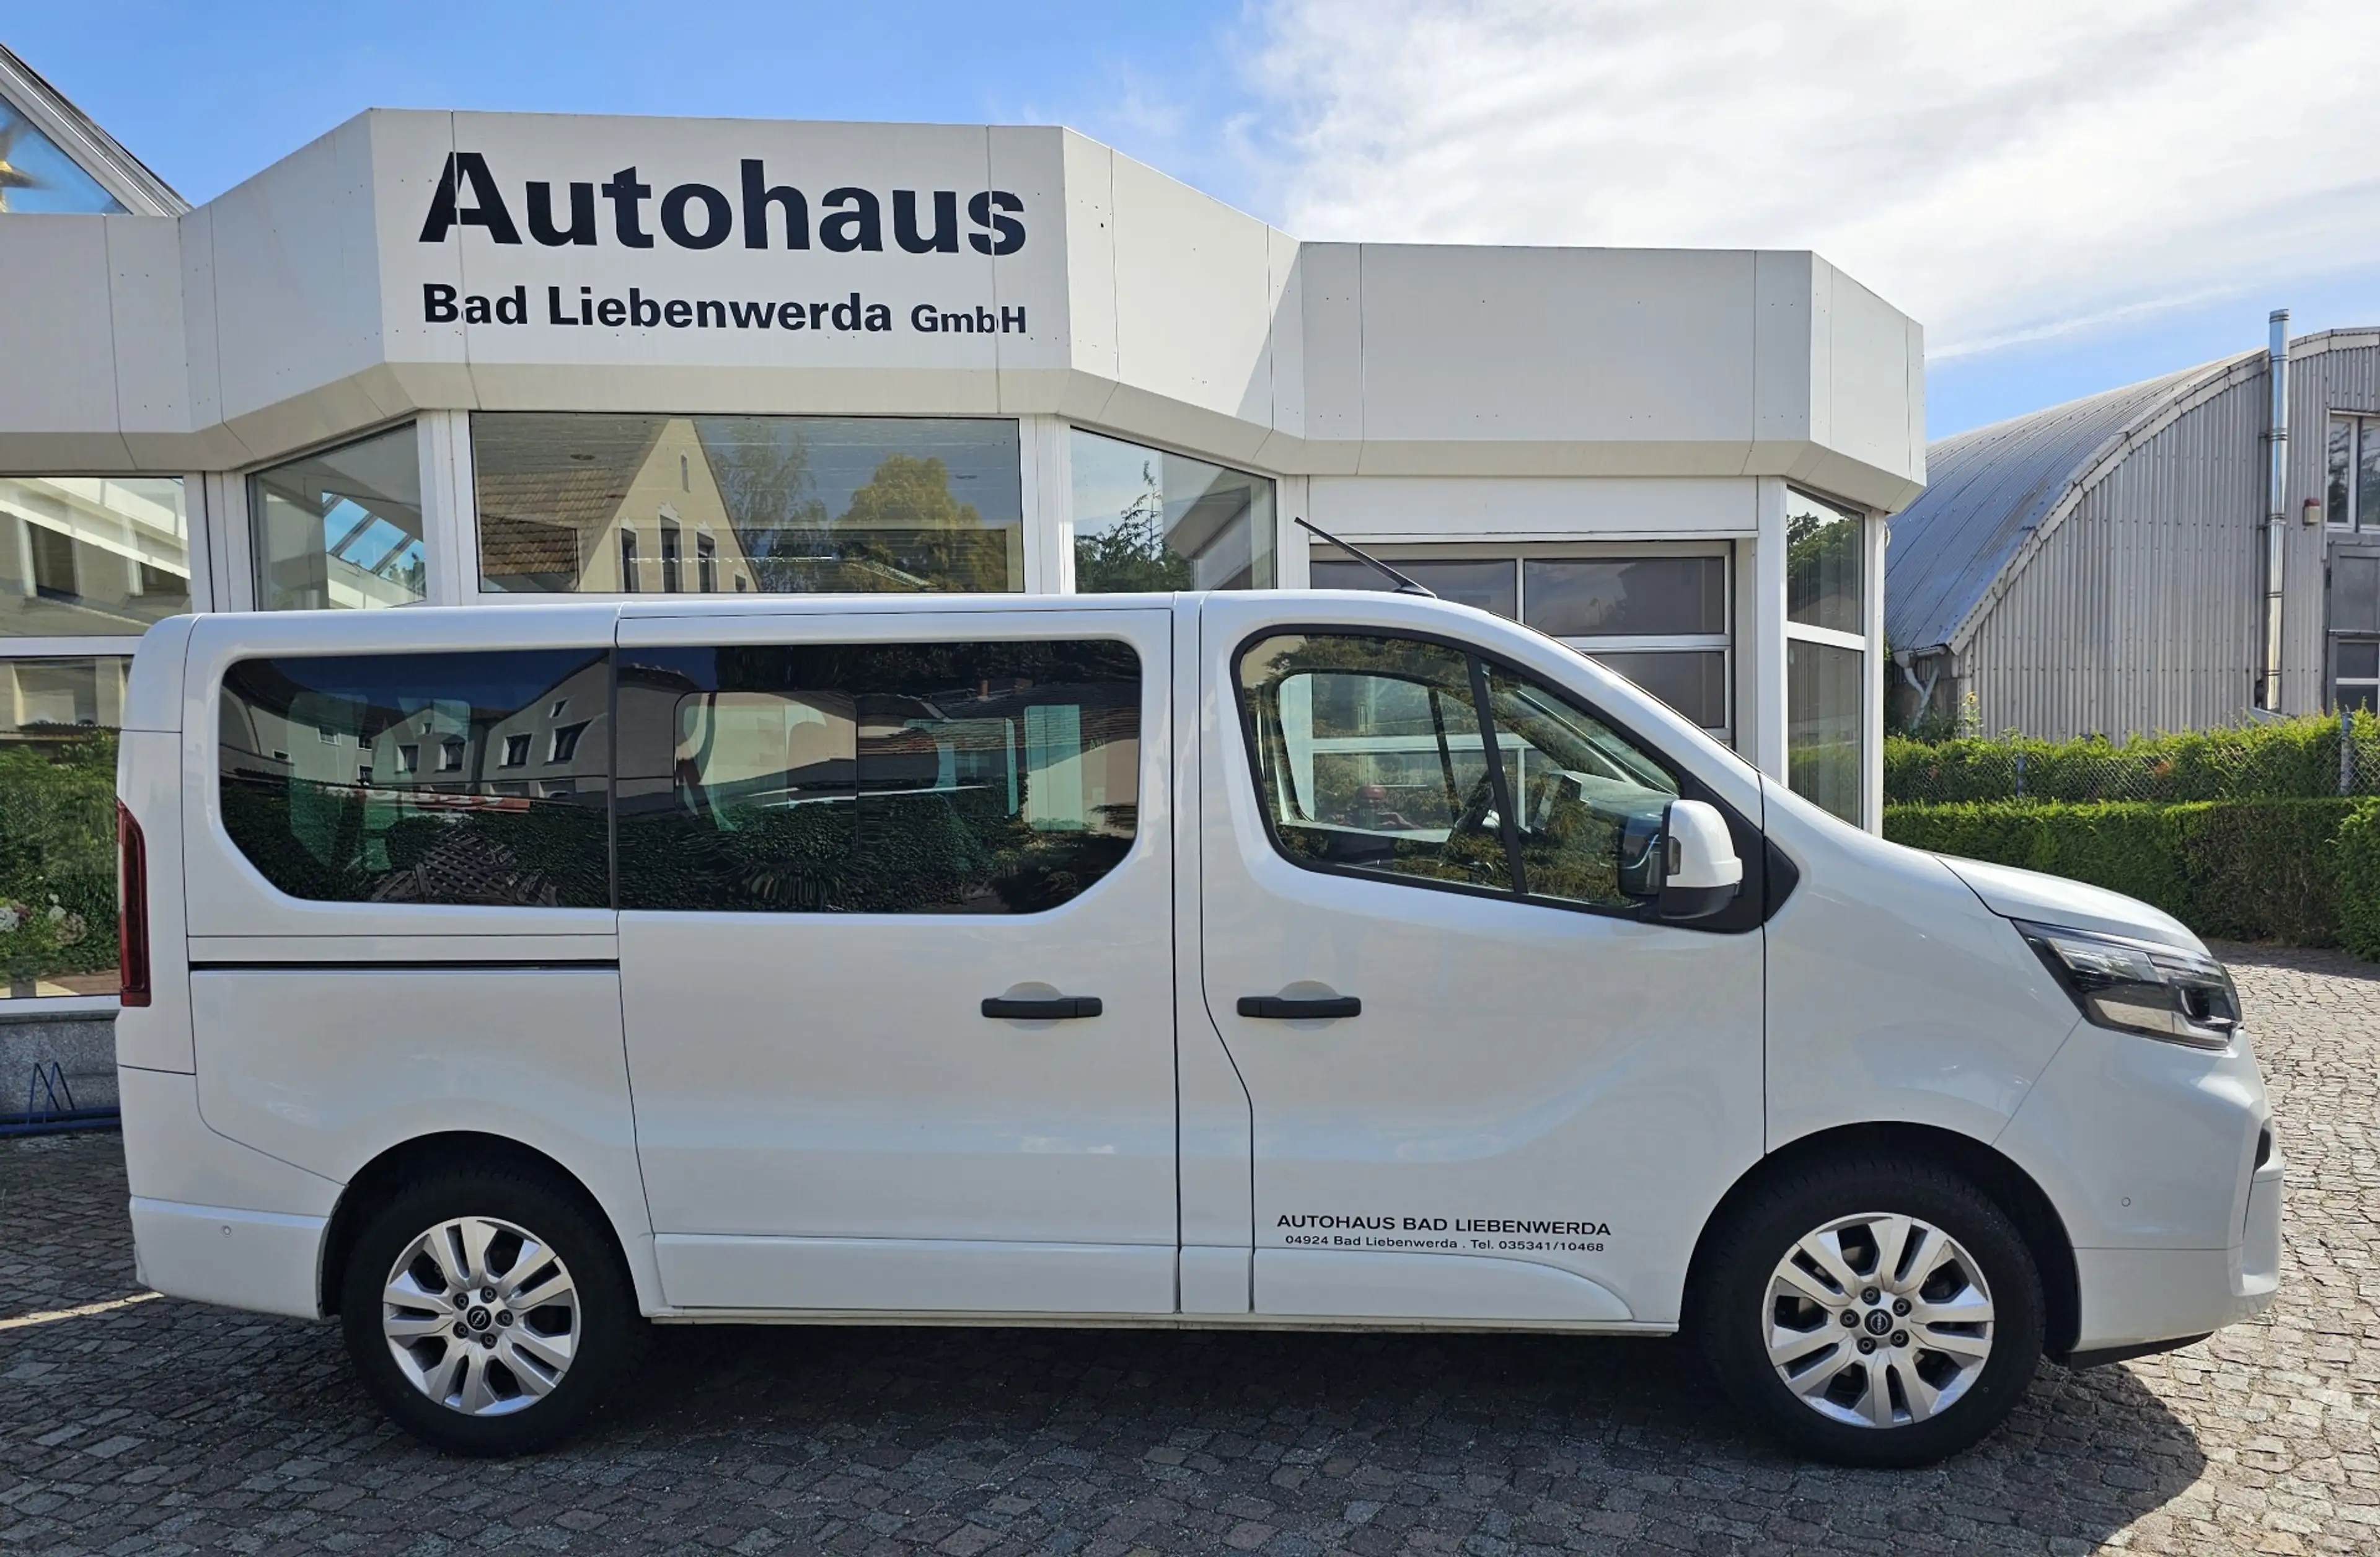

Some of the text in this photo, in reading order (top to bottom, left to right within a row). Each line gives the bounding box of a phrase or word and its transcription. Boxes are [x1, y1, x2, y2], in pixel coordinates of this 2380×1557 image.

[418, 151, 1026, 256] Autohaus
[423, 283, 1026, 333] Bad Liebenwerda GmbH
[1276, 1214, 1611, 1236] AUTOHAUS BAD LIEBENWERDA
[1285, 1235, 1329, 1245] 04924
[1333, 1235, 1361, 1246] Bad
[1365, 1236, 1458, 1249] Liebenwerda
[1470, 1239, 1494, 1250] Tel.
[1498, 1240, 1604, 1252] 035341/10468
